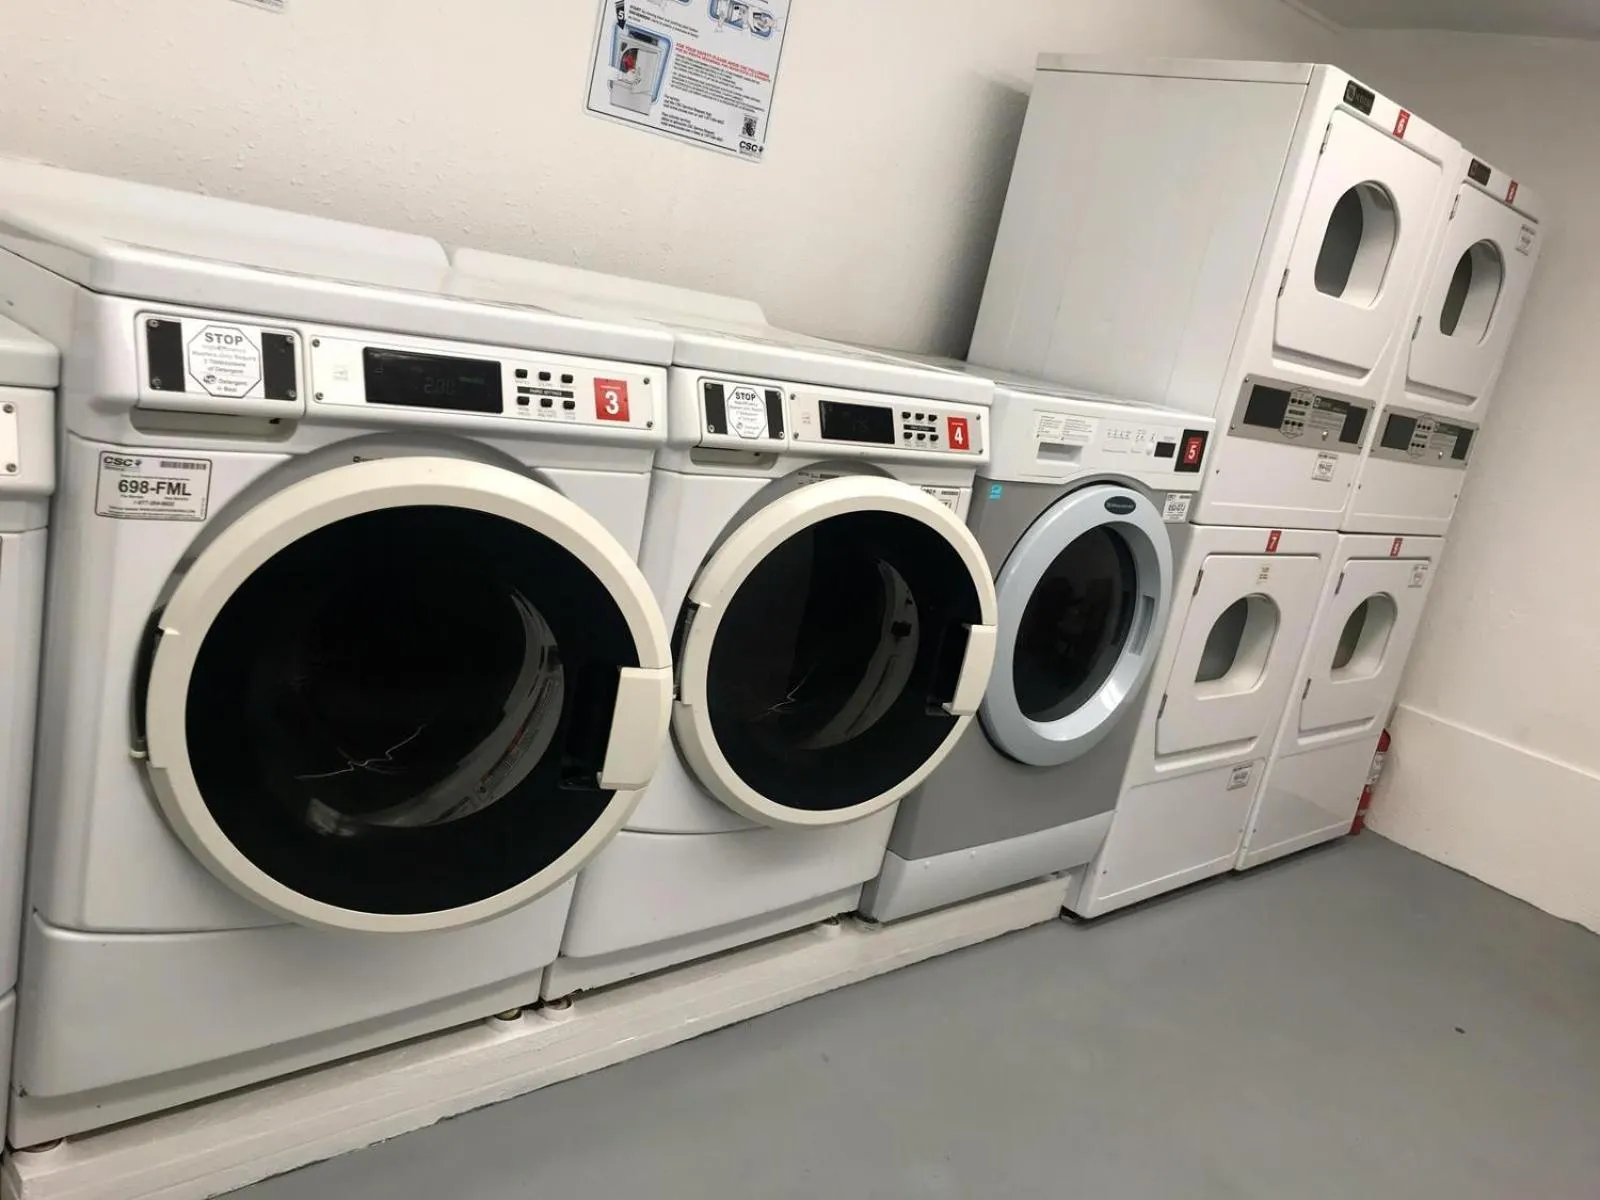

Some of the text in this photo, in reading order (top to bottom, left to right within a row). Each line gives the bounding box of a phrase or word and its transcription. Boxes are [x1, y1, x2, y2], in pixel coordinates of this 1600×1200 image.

[617, 10, 625, 19] 5
[739, 140, 758, 152] CSC
[205, 332, 243, 345] STOP
[605, 390, 620, 415] 3
[735, 391, 756, 401] STOP
[954, 426, 964, 445] 4
[1188, 444, 1199, 460] 5
[103, 455, 133, 467] CSC
[118, 478, 192, 497] 698-FML
